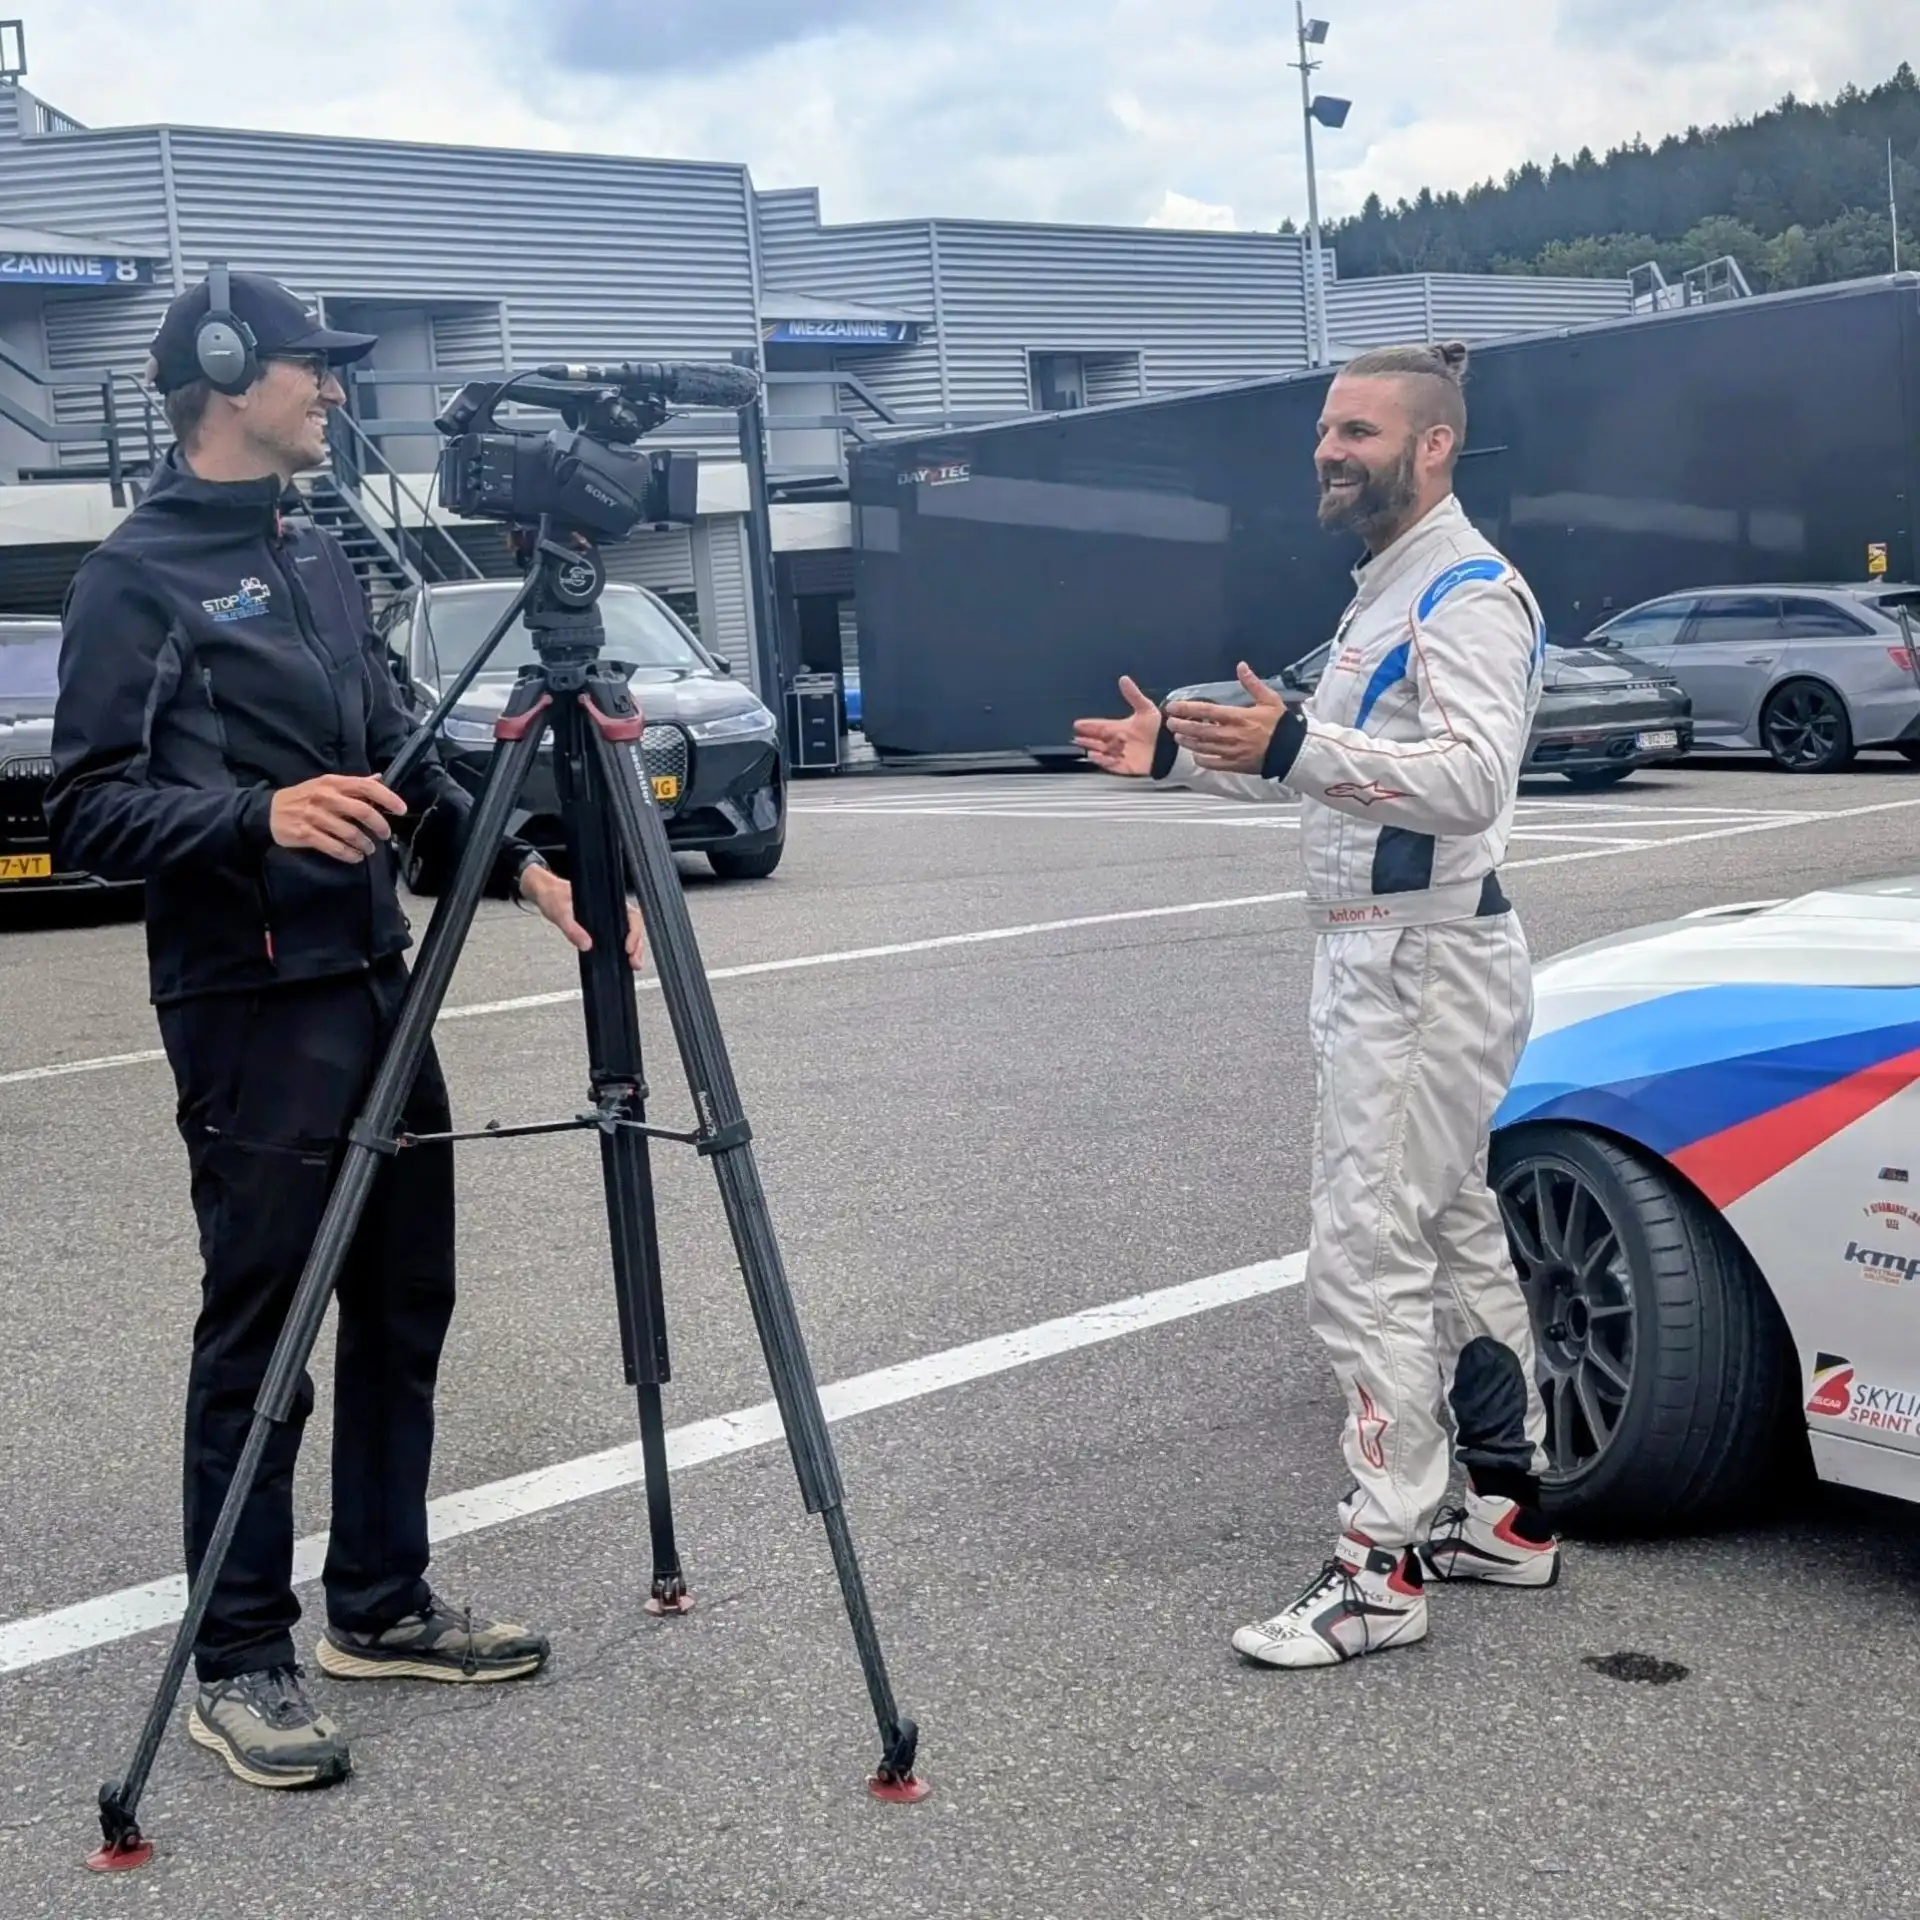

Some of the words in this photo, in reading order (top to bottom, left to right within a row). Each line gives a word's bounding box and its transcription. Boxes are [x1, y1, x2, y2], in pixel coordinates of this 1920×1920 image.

[115, 257, 138, 281] 8
[788, 319, 889, 337] MEZZANINE
[584, 483, 618, 507] SONY
[0, 857, 43, 875] 7-VT
[1328, 908, 1366, 923] Anton
[1848, 1407, 1912, 1433] SPRINT
